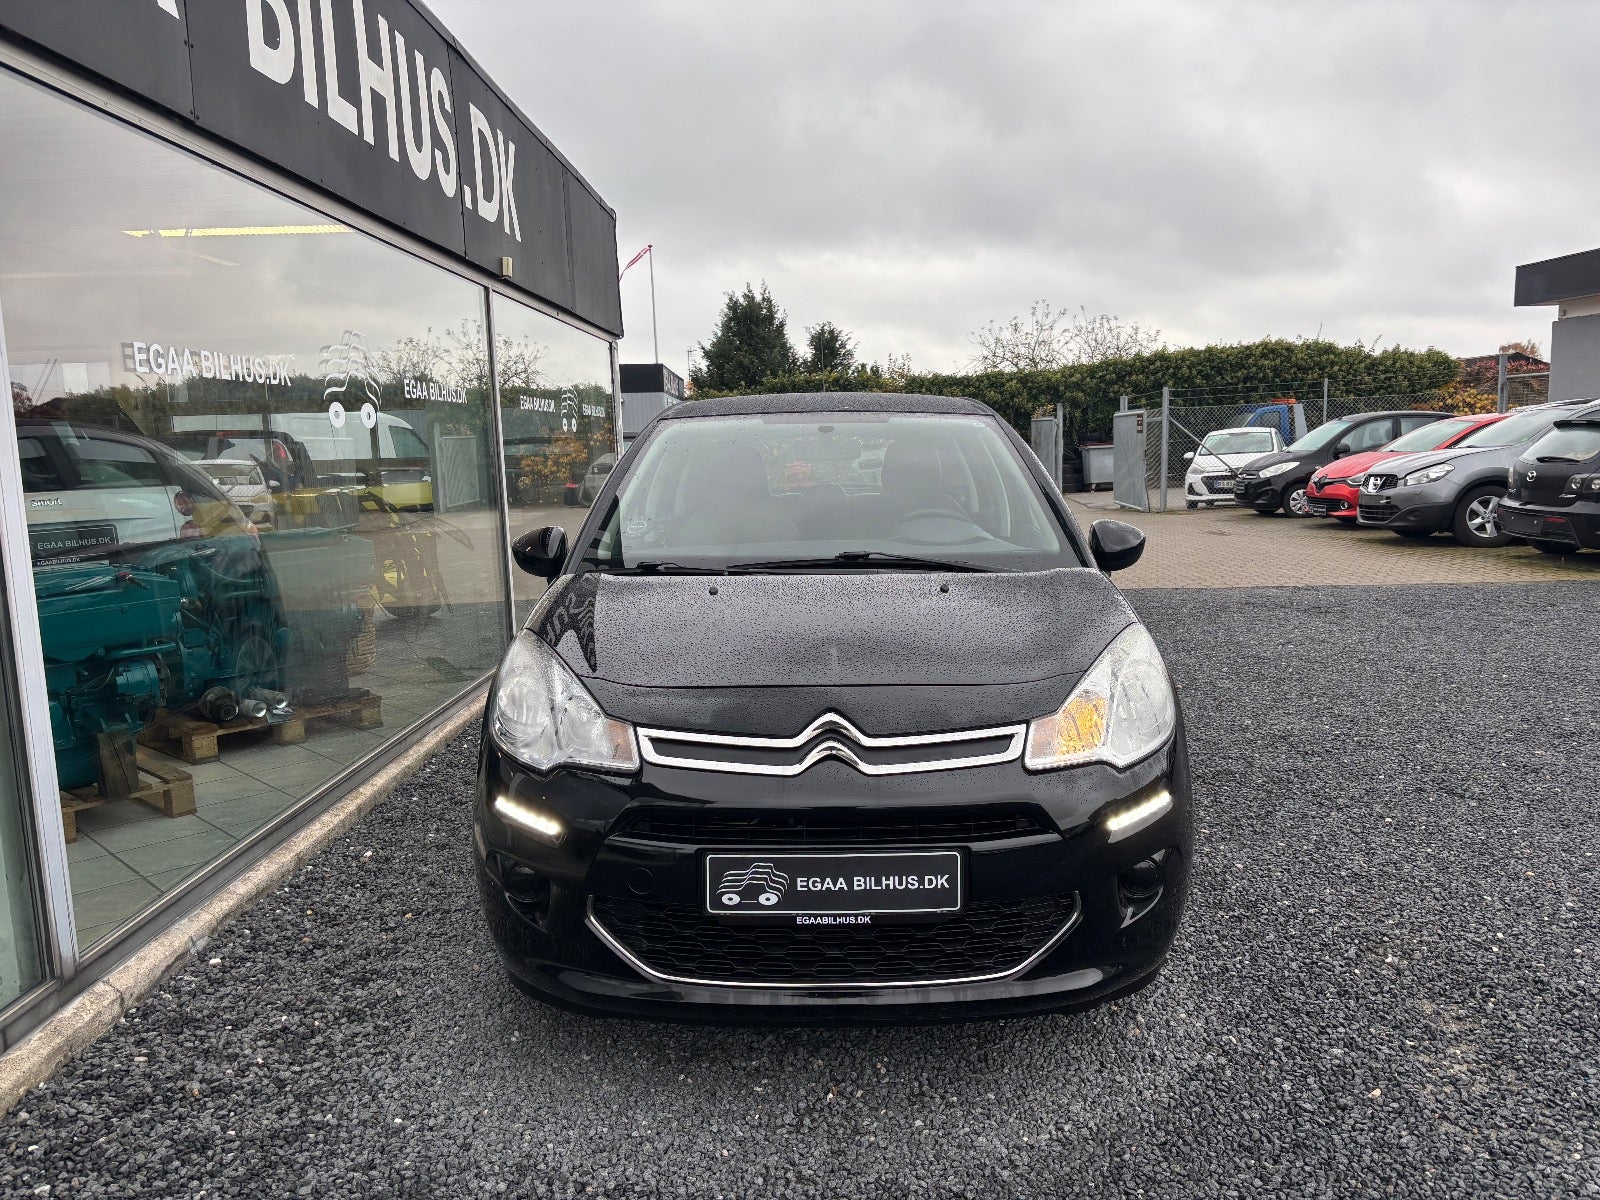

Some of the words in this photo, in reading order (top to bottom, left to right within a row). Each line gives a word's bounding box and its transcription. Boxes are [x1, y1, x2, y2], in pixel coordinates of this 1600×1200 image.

[133, 341, 196, 377] EGAA
[200, 349, 292, 387] BILHUS.DK
[404, 379, 429, 400] EGAA
[429, 382, 468, 404] BILHUS.DK
[31, 498, 62, 507] smart
[37, 541, 64, 550] EGAA
[65, 536, 112, 548] BILHUS.DK
[796, 877, 848, 891] EGAA
[853, 874, 950, 891] BILHUS.DK
[796, 915, 872, 925] EGAABILHUS.DK
